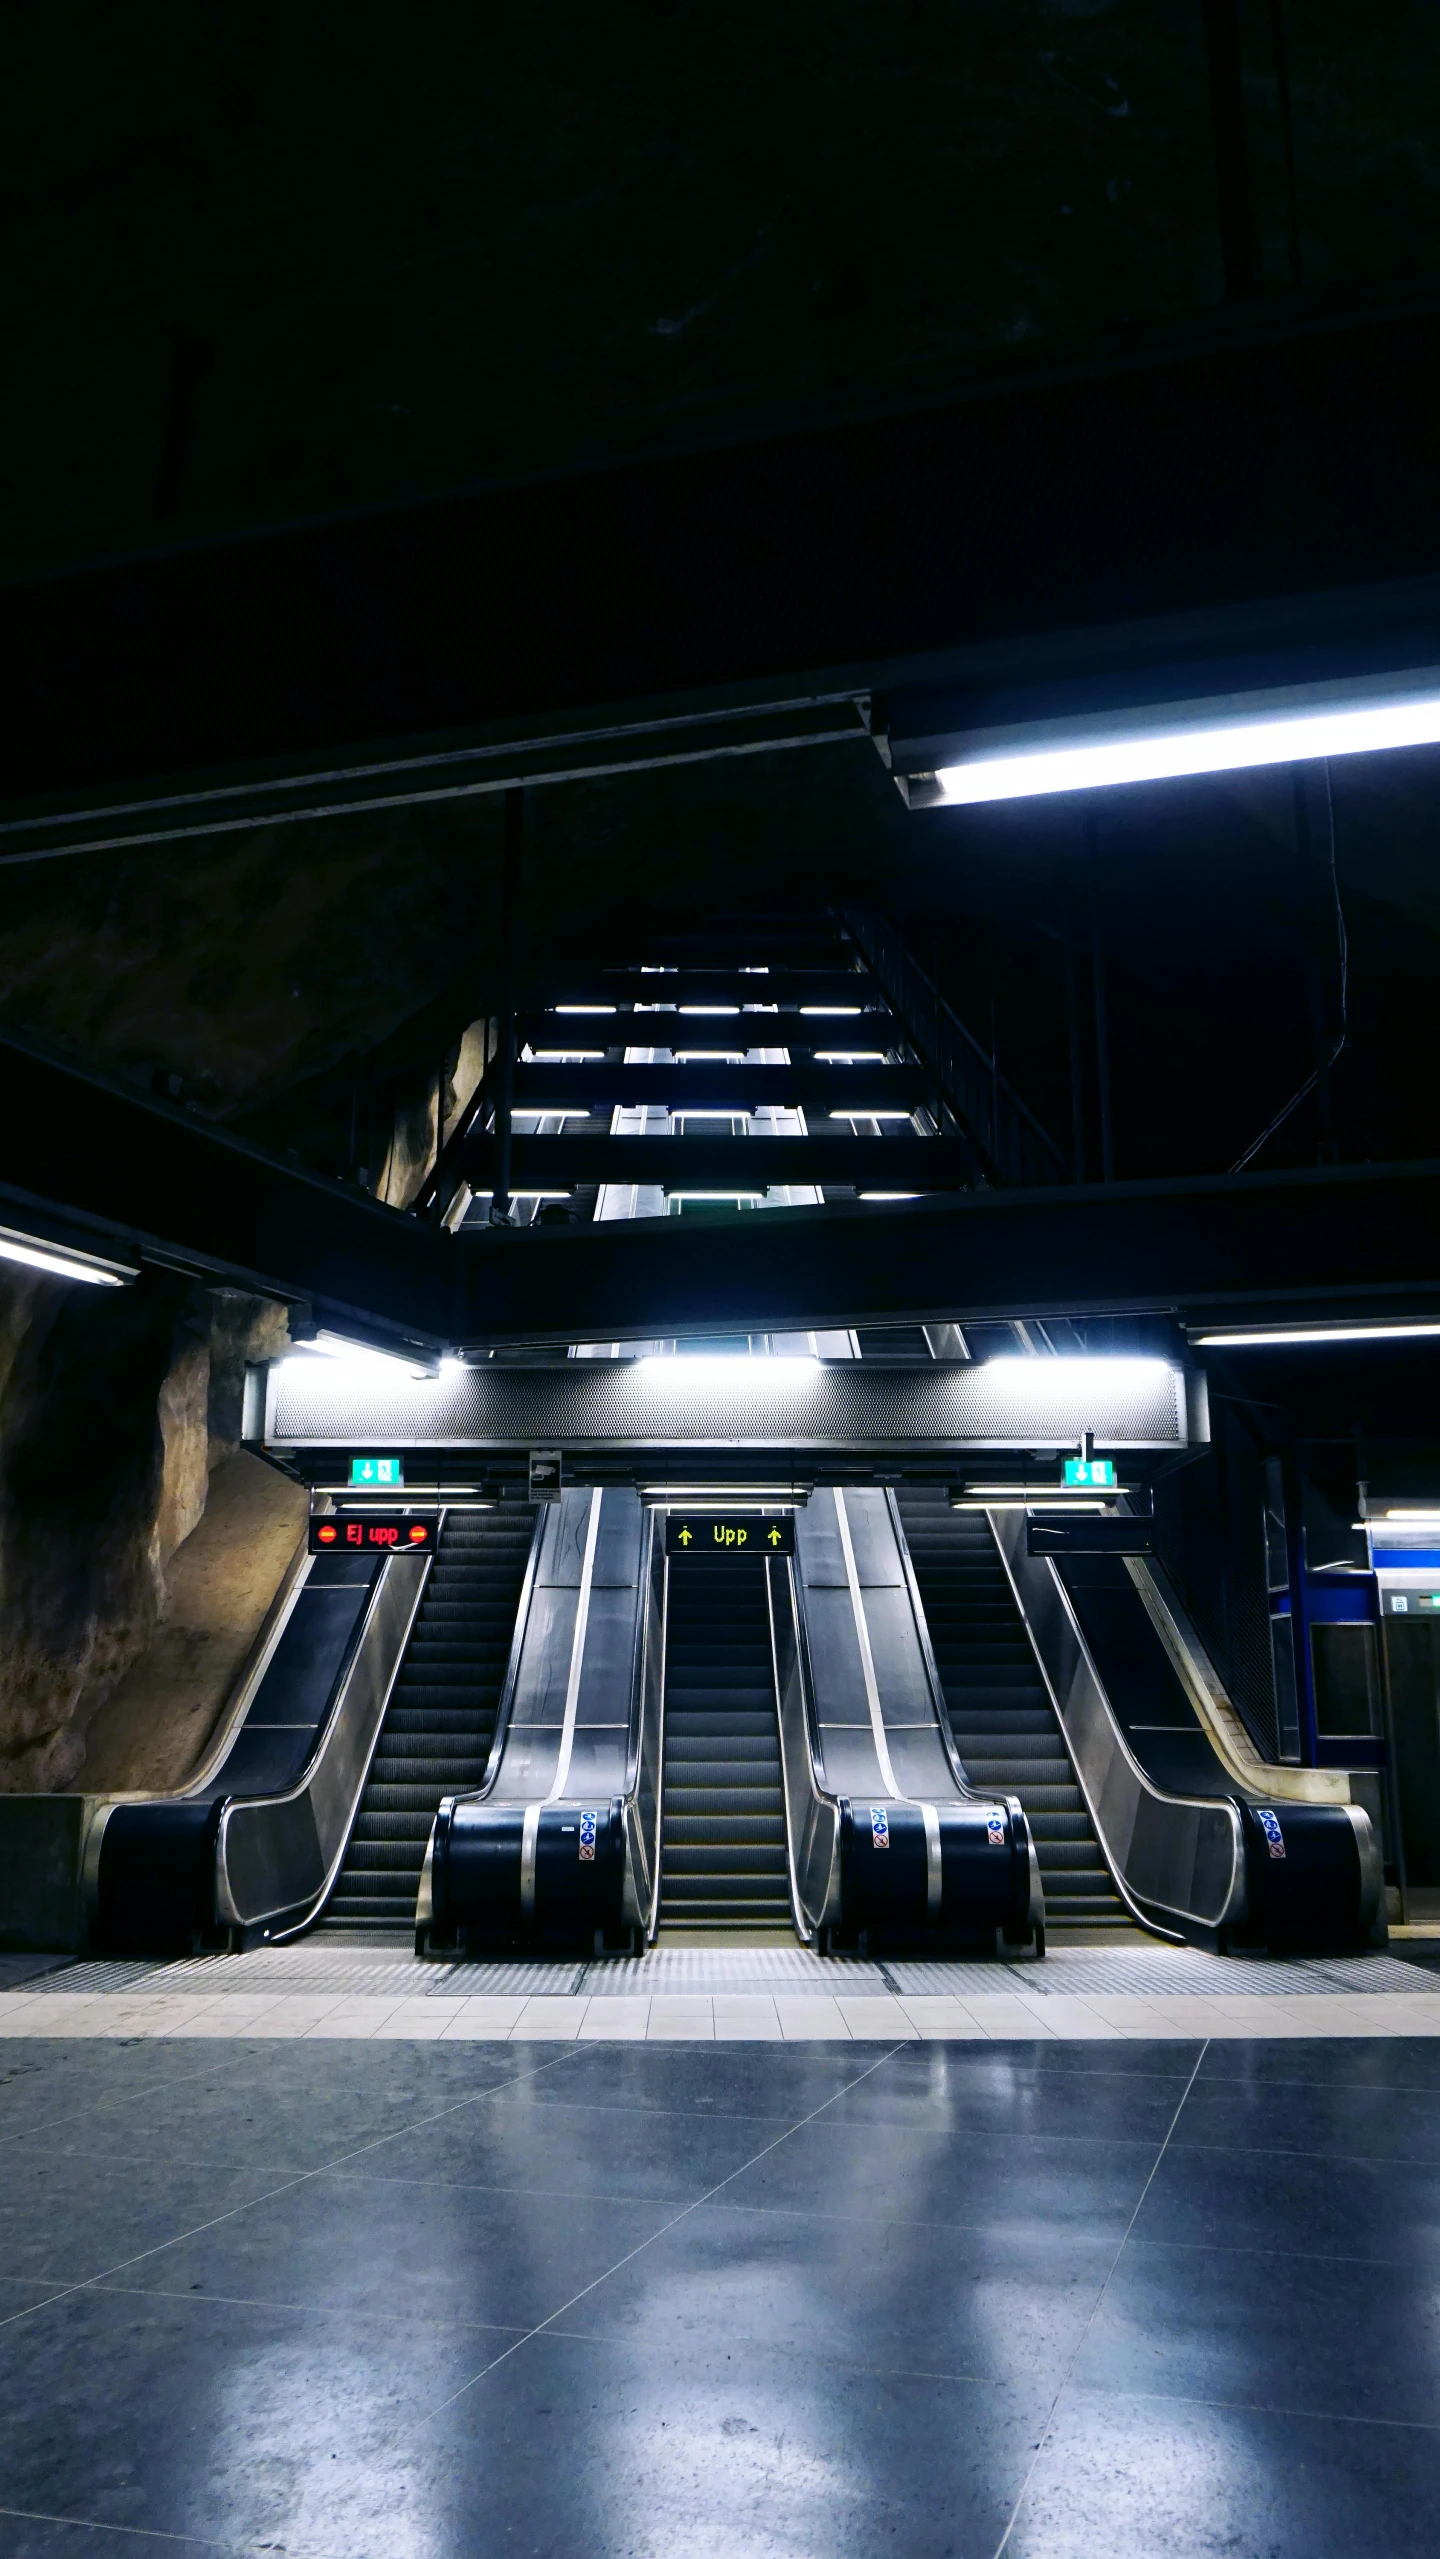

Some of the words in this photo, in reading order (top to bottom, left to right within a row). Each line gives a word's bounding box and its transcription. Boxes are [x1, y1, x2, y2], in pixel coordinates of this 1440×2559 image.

[346, 1524, 363, 1545] Ej
[368, 1526, 399, 1545] upp
[713, 1525, 748, 1546] Upp
